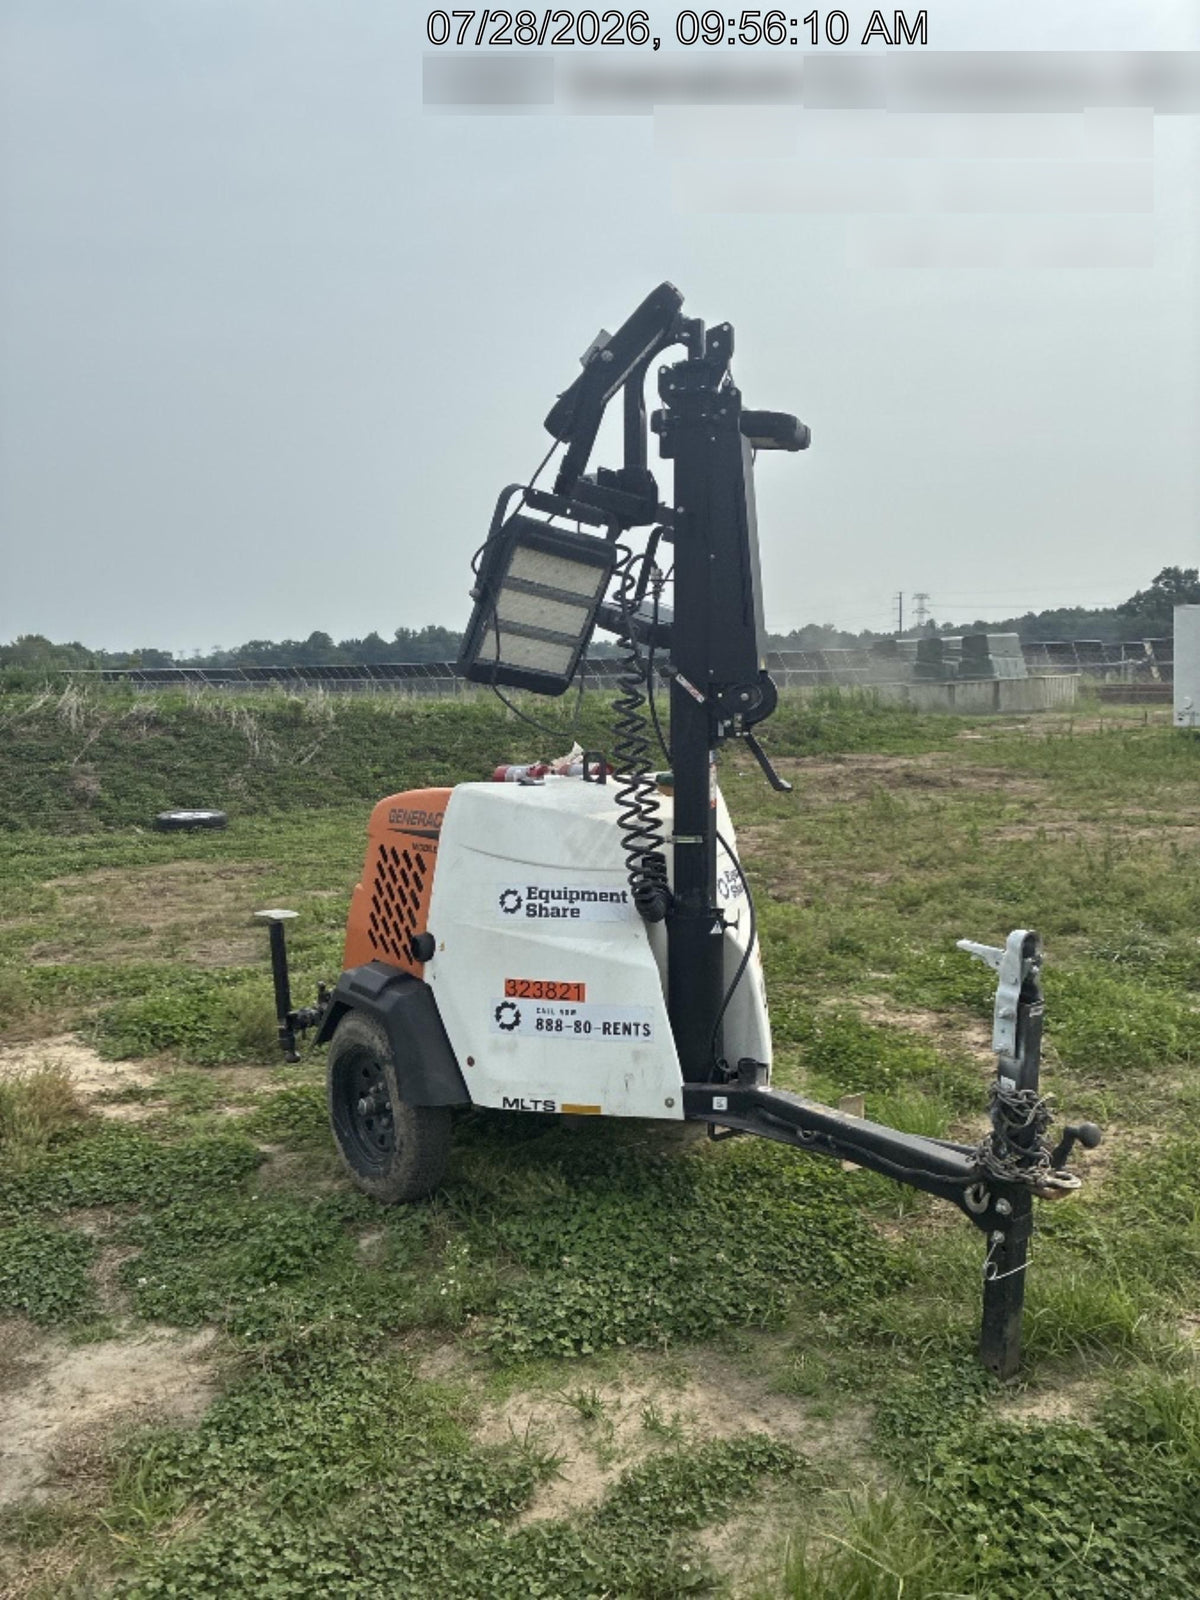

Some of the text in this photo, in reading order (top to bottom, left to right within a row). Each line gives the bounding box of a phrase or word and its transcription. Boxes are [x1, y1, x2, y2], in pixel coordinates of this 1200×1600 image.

[388, 807, 445, 829] GENERAC
[525, 886, 628, 904] Equipment
[525, 902, 581, 918] Share
[506, 979, 582, 1001] 323821
[535, 1017, 652, 1037] 888-80-RENTS
[502, 1096, 556, 1112] MLTS
